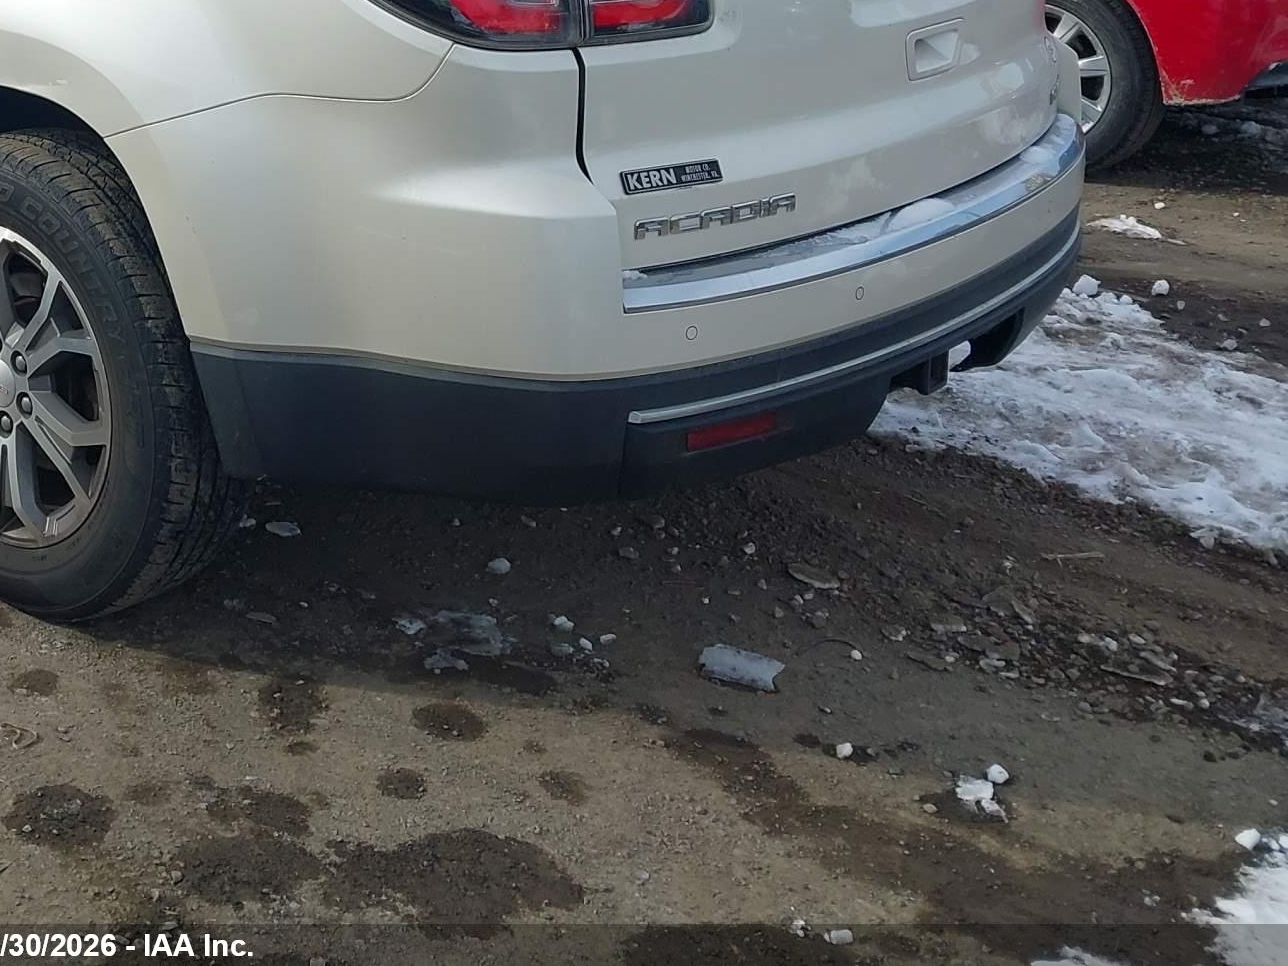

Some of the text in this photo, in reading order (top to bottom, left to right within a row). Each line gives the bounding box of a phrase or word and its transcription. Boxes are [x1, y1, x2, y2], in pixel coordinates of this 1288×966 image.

[626, 168, 677, 190] KERN
[633, 192, 797, 241] ACADIA
[19, 191, 126, 344] COUNTRY
